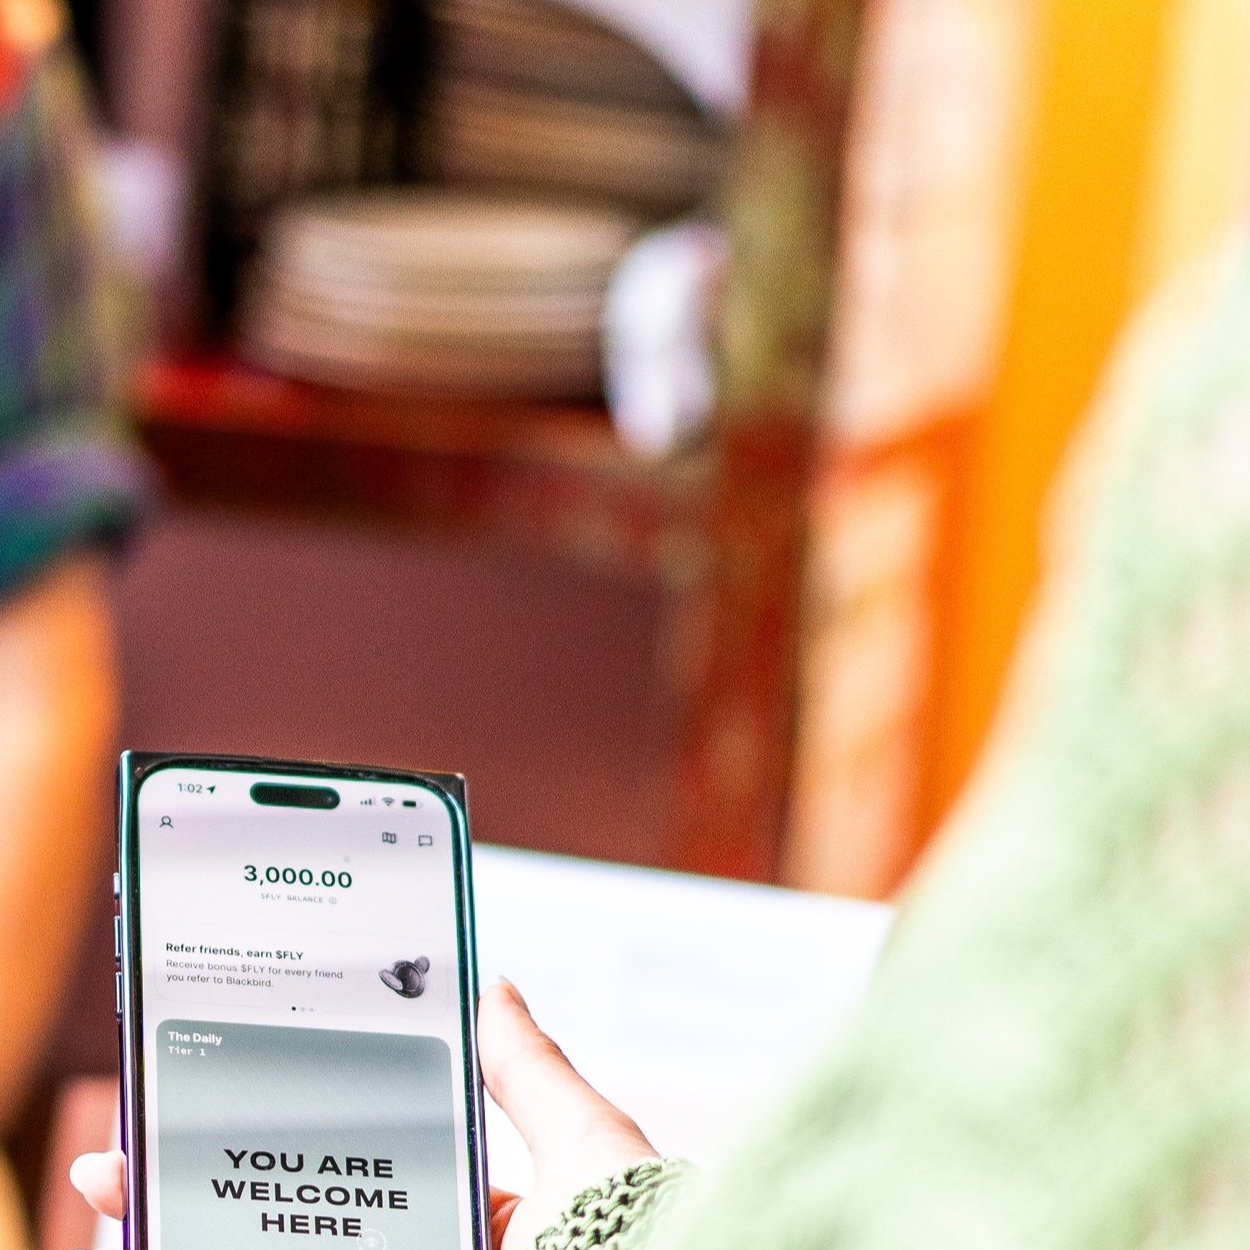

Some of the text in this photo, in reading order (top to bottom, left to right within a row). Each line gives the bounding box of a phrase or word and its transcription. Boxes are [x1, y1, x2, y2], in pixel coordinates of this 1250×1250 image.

[178, 783, 203, 794] 1:02
[244, 865, 353, 888] 3,000.00
[287, 895, 323, 904] BALANCE
[166, 942, 304, 961] Refer friends, earn $FLY
[166, 959, 344, 980] Receive bonus $FLY for every friend
[166, 973, 274, 988] you refer to Blackbird.
[168, 1031, 222, 1047] The Daily
[168, 1045, 207, 1057] Tier 1
[223, 1148, 394, 1179] YOU ARE
[211, 1178, 409, 1210] WELCOME
[261, 1212, 363, 1238] HERE
